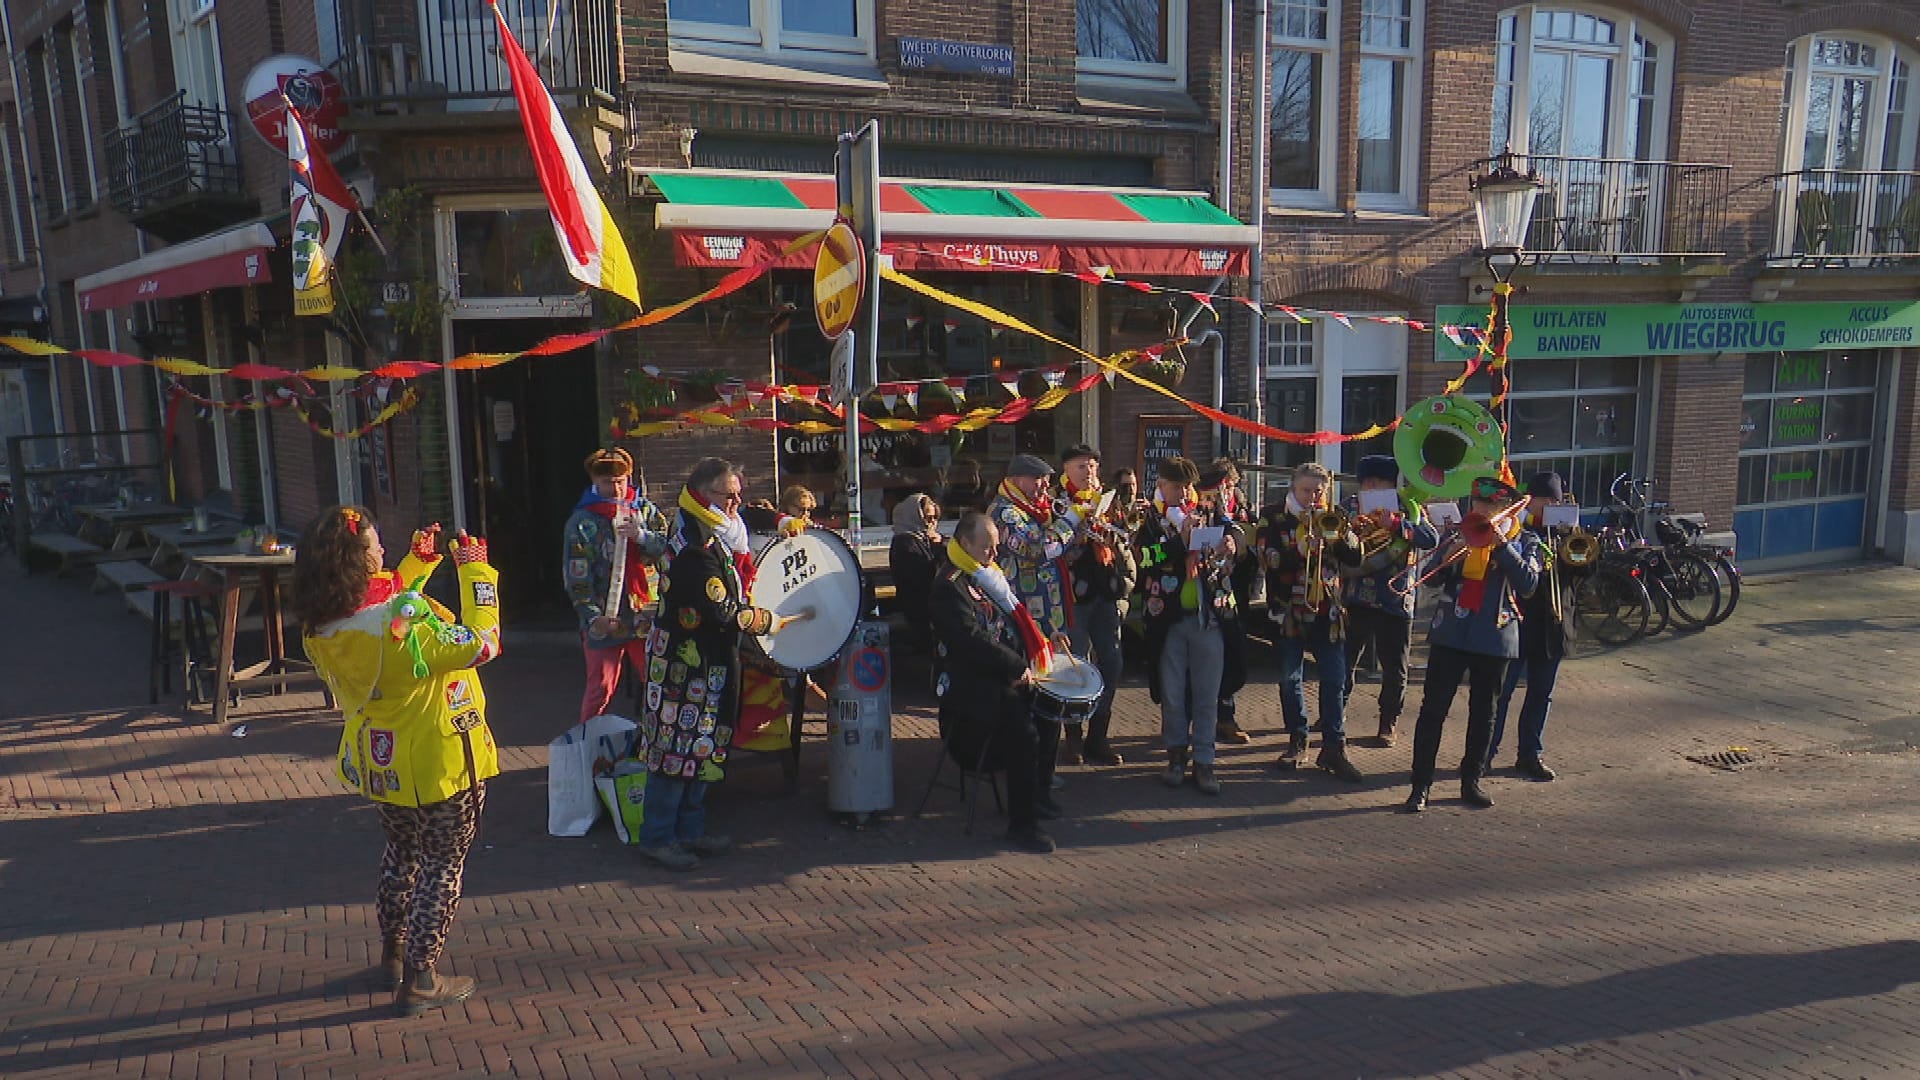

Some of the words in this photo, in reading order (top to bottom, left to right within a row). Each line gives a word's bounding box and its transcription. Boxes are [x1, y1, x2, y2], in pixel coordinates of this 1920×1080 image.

[901, 40, 938, 55] TWEEDE
[942, 44, 1012, 61] KOSTVERLOREN
[900, 54, 925, 68] KADE
[981, 65, 1011, 75] OUD-WEST
[272, 121, 337, 139] Jler
[703, 236, 745, 248] EEUWIGE
[943, 244, 981, 259] Cé
[985, 244, 1039, 263] Thuys
[1533, 311, 1606, 328] UITLATEN
[1680, 307, 1755, 320] AUTOSERVICE
[1537, 335, 1600, 352] BANDEN
[1646, 320, 1785, 350] WIEGBRUG
[1819, 327, 1912, 344] SCHOKDEMPERS
[1778, 358, 1821, 384] APK
[1779, 423, 1816, 440] STATION
[784, 435, 830, 454] Café
[832, 433, 893, 453] Tuys
[781, 548, 808, 576] PB
[782, 564, 817, 593] BAND
